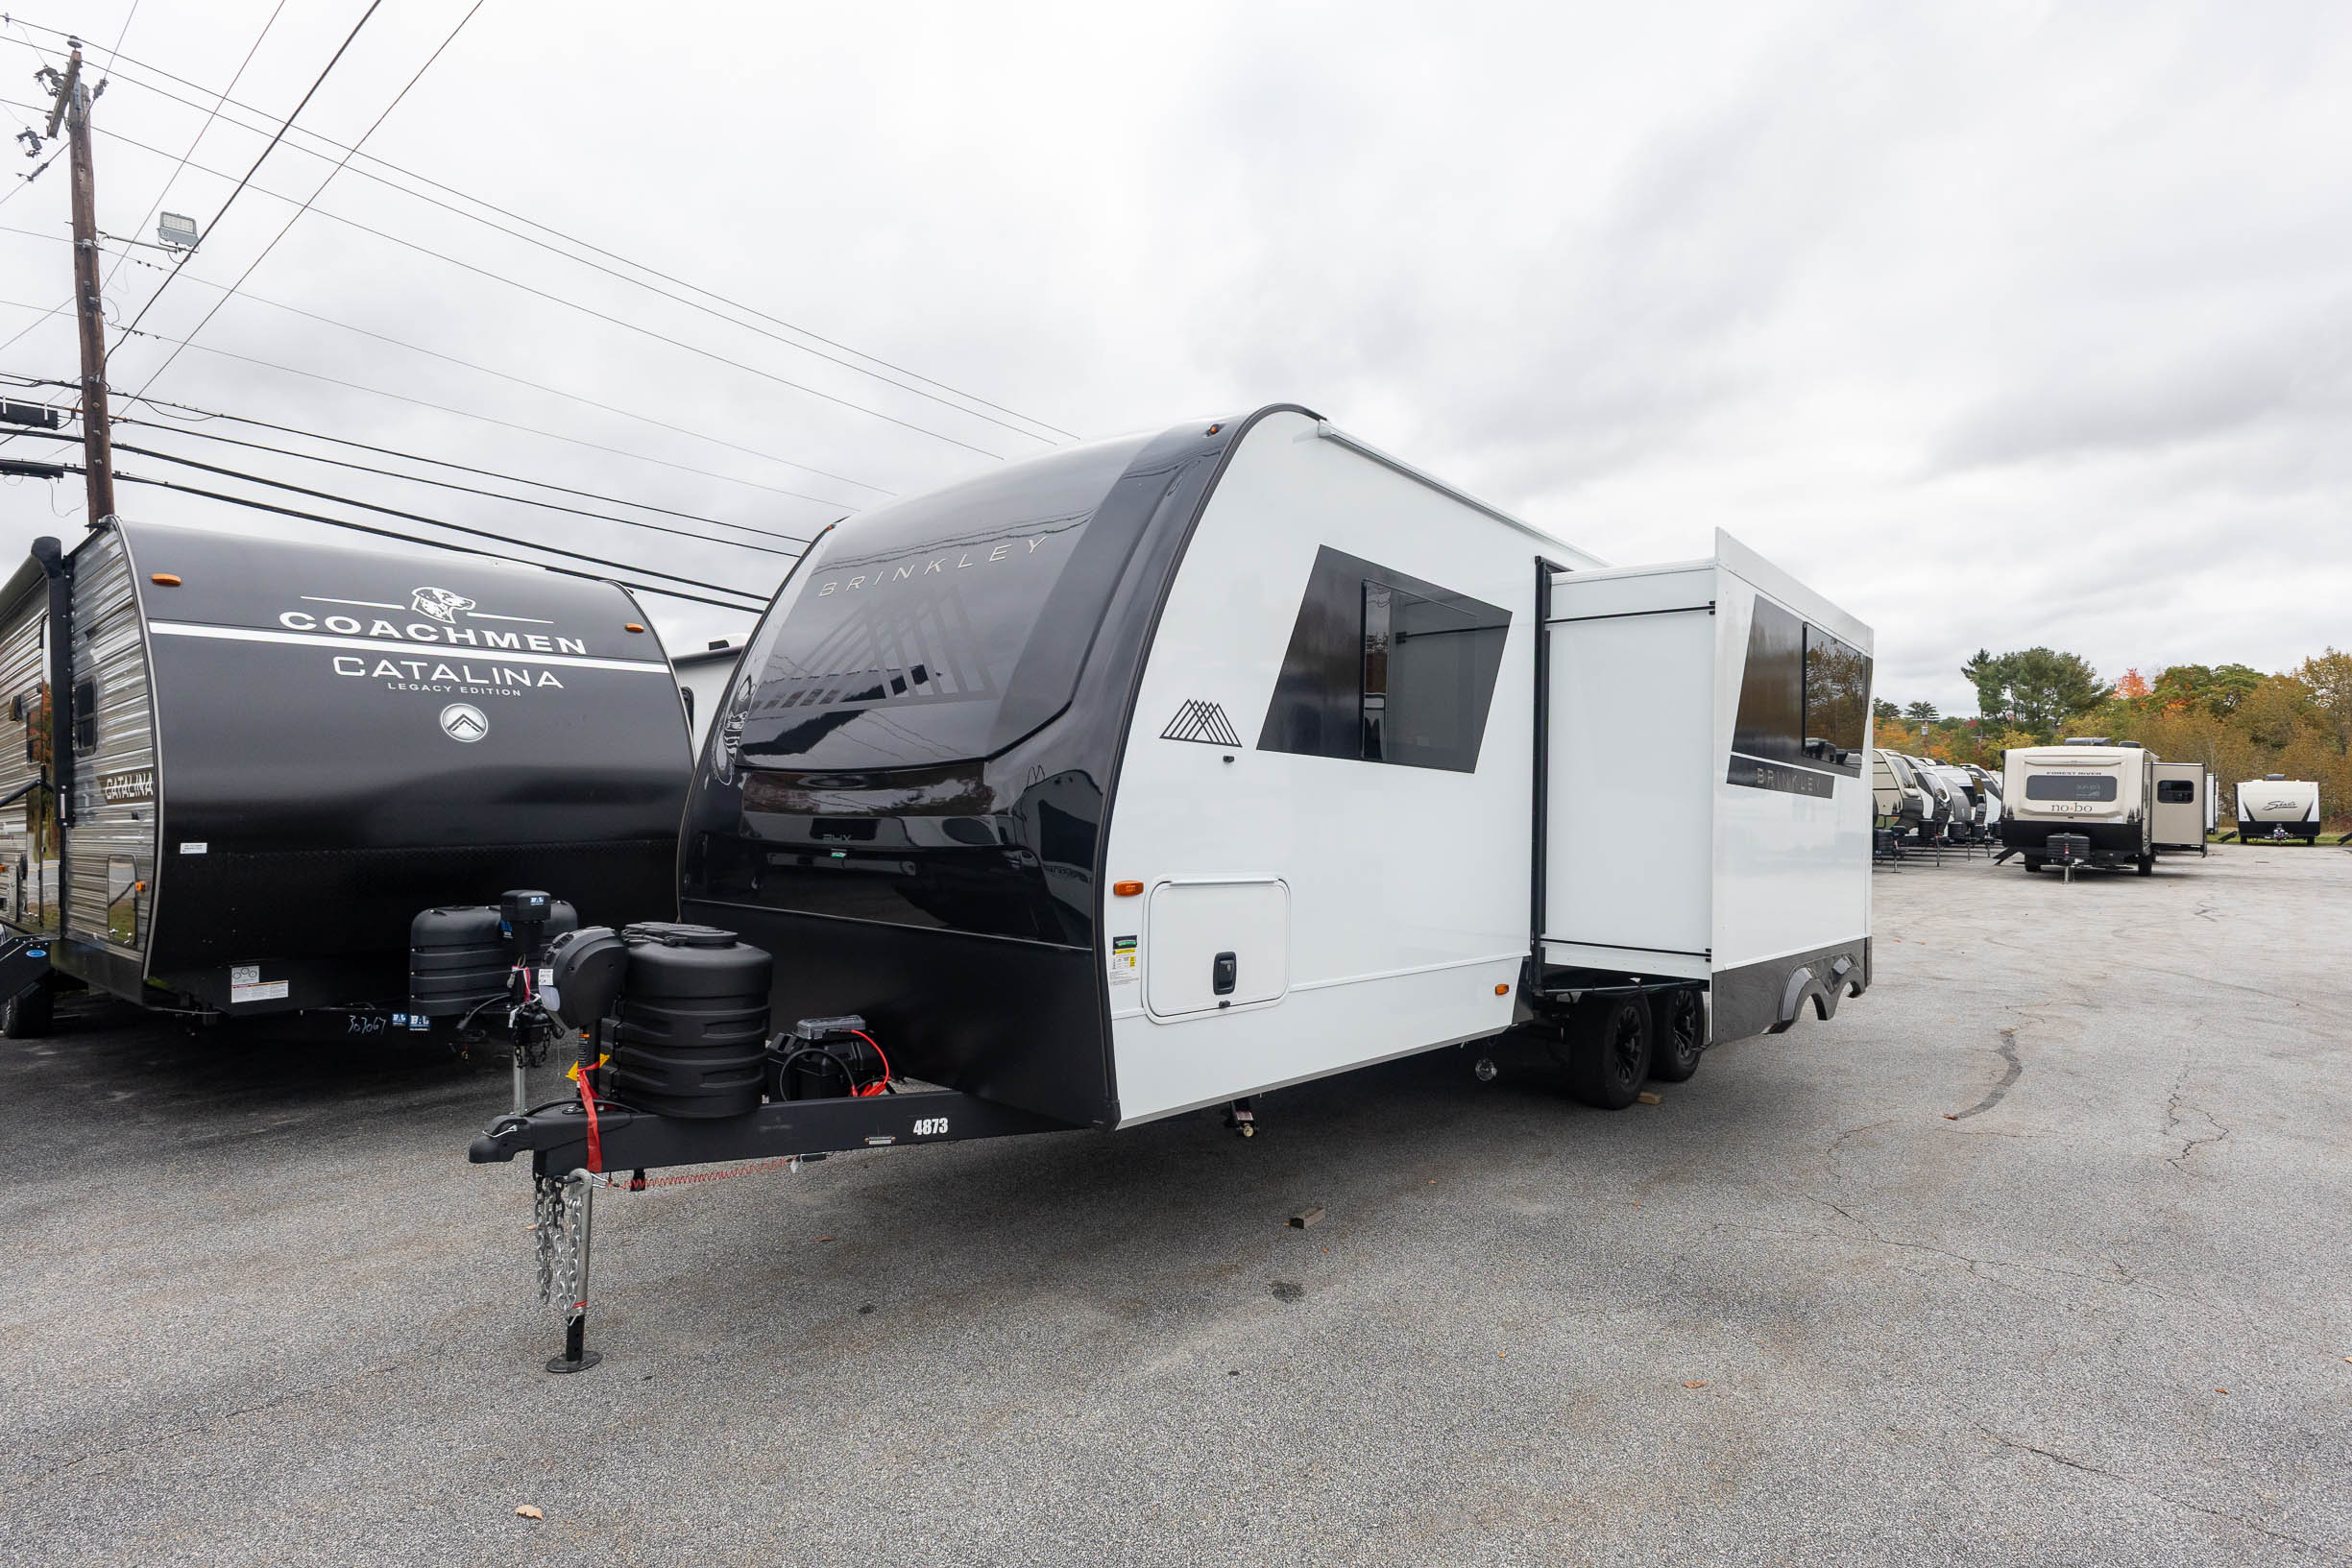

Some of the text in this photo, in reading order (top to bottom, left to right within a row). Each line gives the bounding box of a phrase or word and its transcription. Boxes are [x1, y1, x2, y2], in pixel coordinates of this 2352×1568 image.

[818, 536, 1048, 597] BRINKLEY
[279, 611, 587, 655] COACHMEN
[332, 656, 565, 689] CATALINA
[387, 682, 522, 697] LEGACY EDITION
[105, 772, 154, 800] CATALINA
[1757, 767, 1821, 792] BRINKLEY
[912, 1117, 949, 1136] 4873
